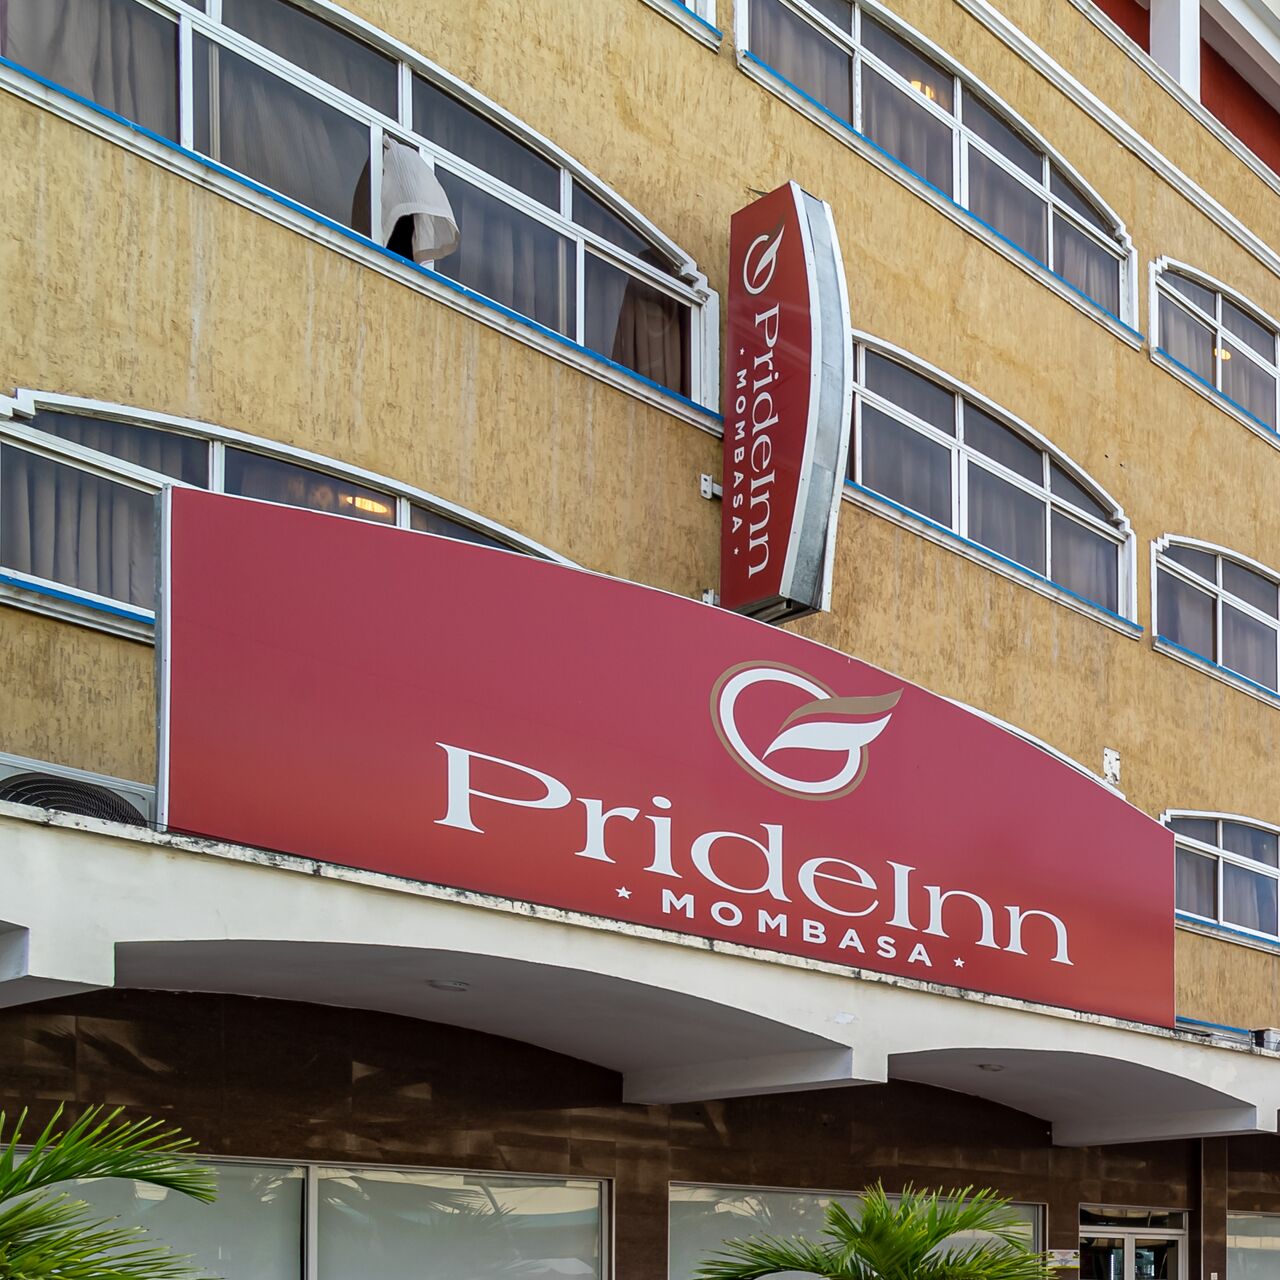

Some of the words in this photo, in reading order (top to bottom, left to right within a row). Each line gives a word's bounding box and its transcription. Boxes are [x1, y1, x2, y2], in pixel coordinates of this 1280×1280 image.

[731, 370, 747, 535] MOMBASA
[748, 302, 780, 579] PrideInn
[434, 742, 1074, 966] PrideInn
[663, 889, 933, 967] MOMBASA
